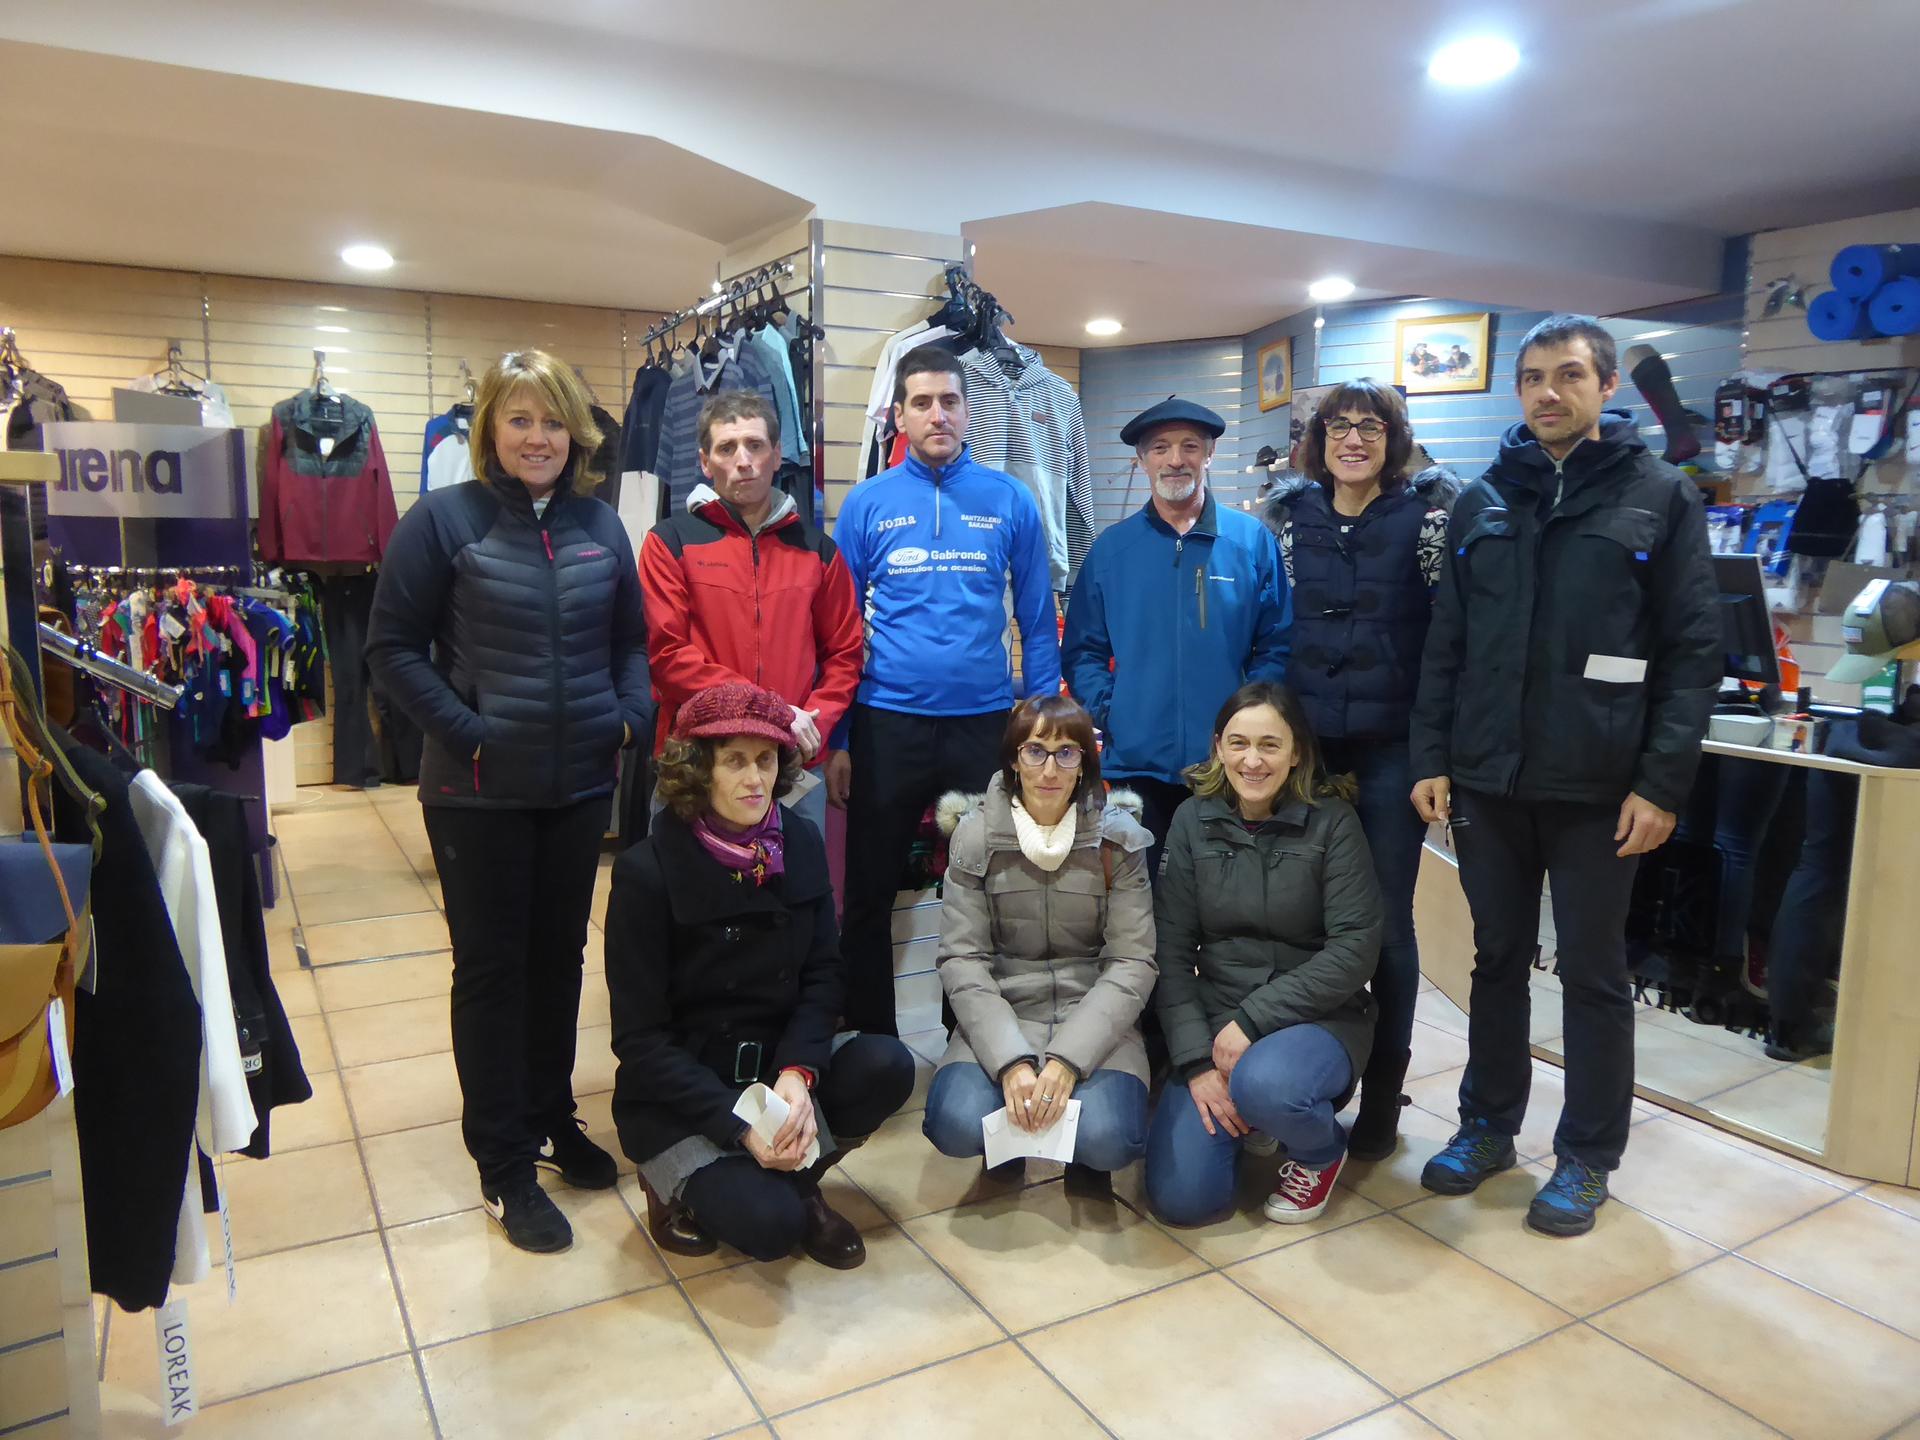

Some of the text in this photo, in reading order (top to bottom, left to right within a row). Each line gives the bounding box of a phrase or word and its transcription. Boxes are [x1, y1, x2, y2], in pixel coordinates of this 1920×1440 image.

[877, 515, 917, 532] Joma
[895, 549, 987, 563] Ford Gabirondo
[163, 1323, 192, 1418] LOREAK
